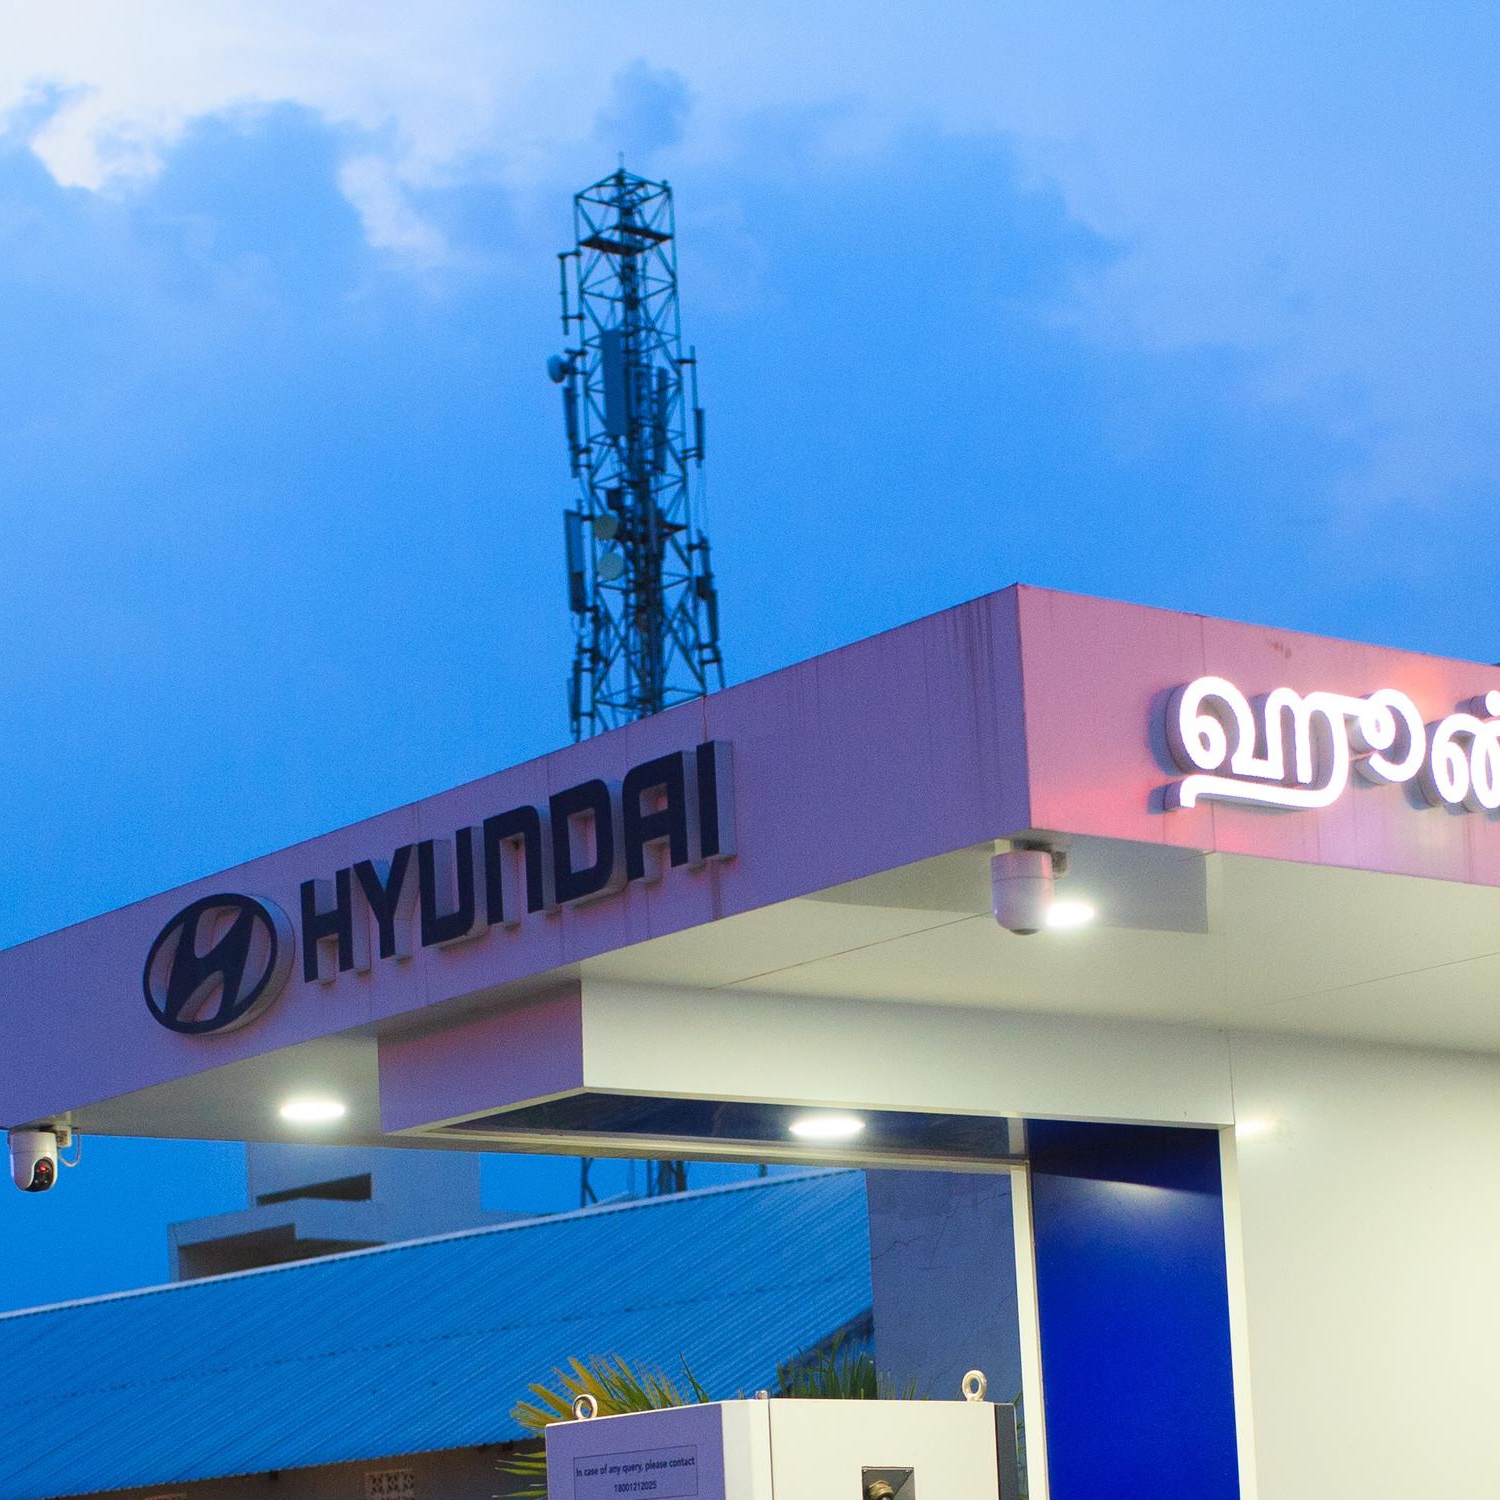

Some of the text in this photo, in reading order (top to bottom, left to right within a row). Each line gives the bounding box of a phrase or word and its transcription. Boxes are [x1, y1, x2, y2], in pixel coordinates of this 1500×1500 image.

[300, 740, 734, 984] HYUNDAI
[576, 1467, 583, 1477] In
[584, 1466, 599, 1477] case
[600, 1464, 607, 1475] of
[608, 1465, 621, 1476] any
[645, 1459, 668, 1472] please
[669, 1456, 695, 1468] contact
